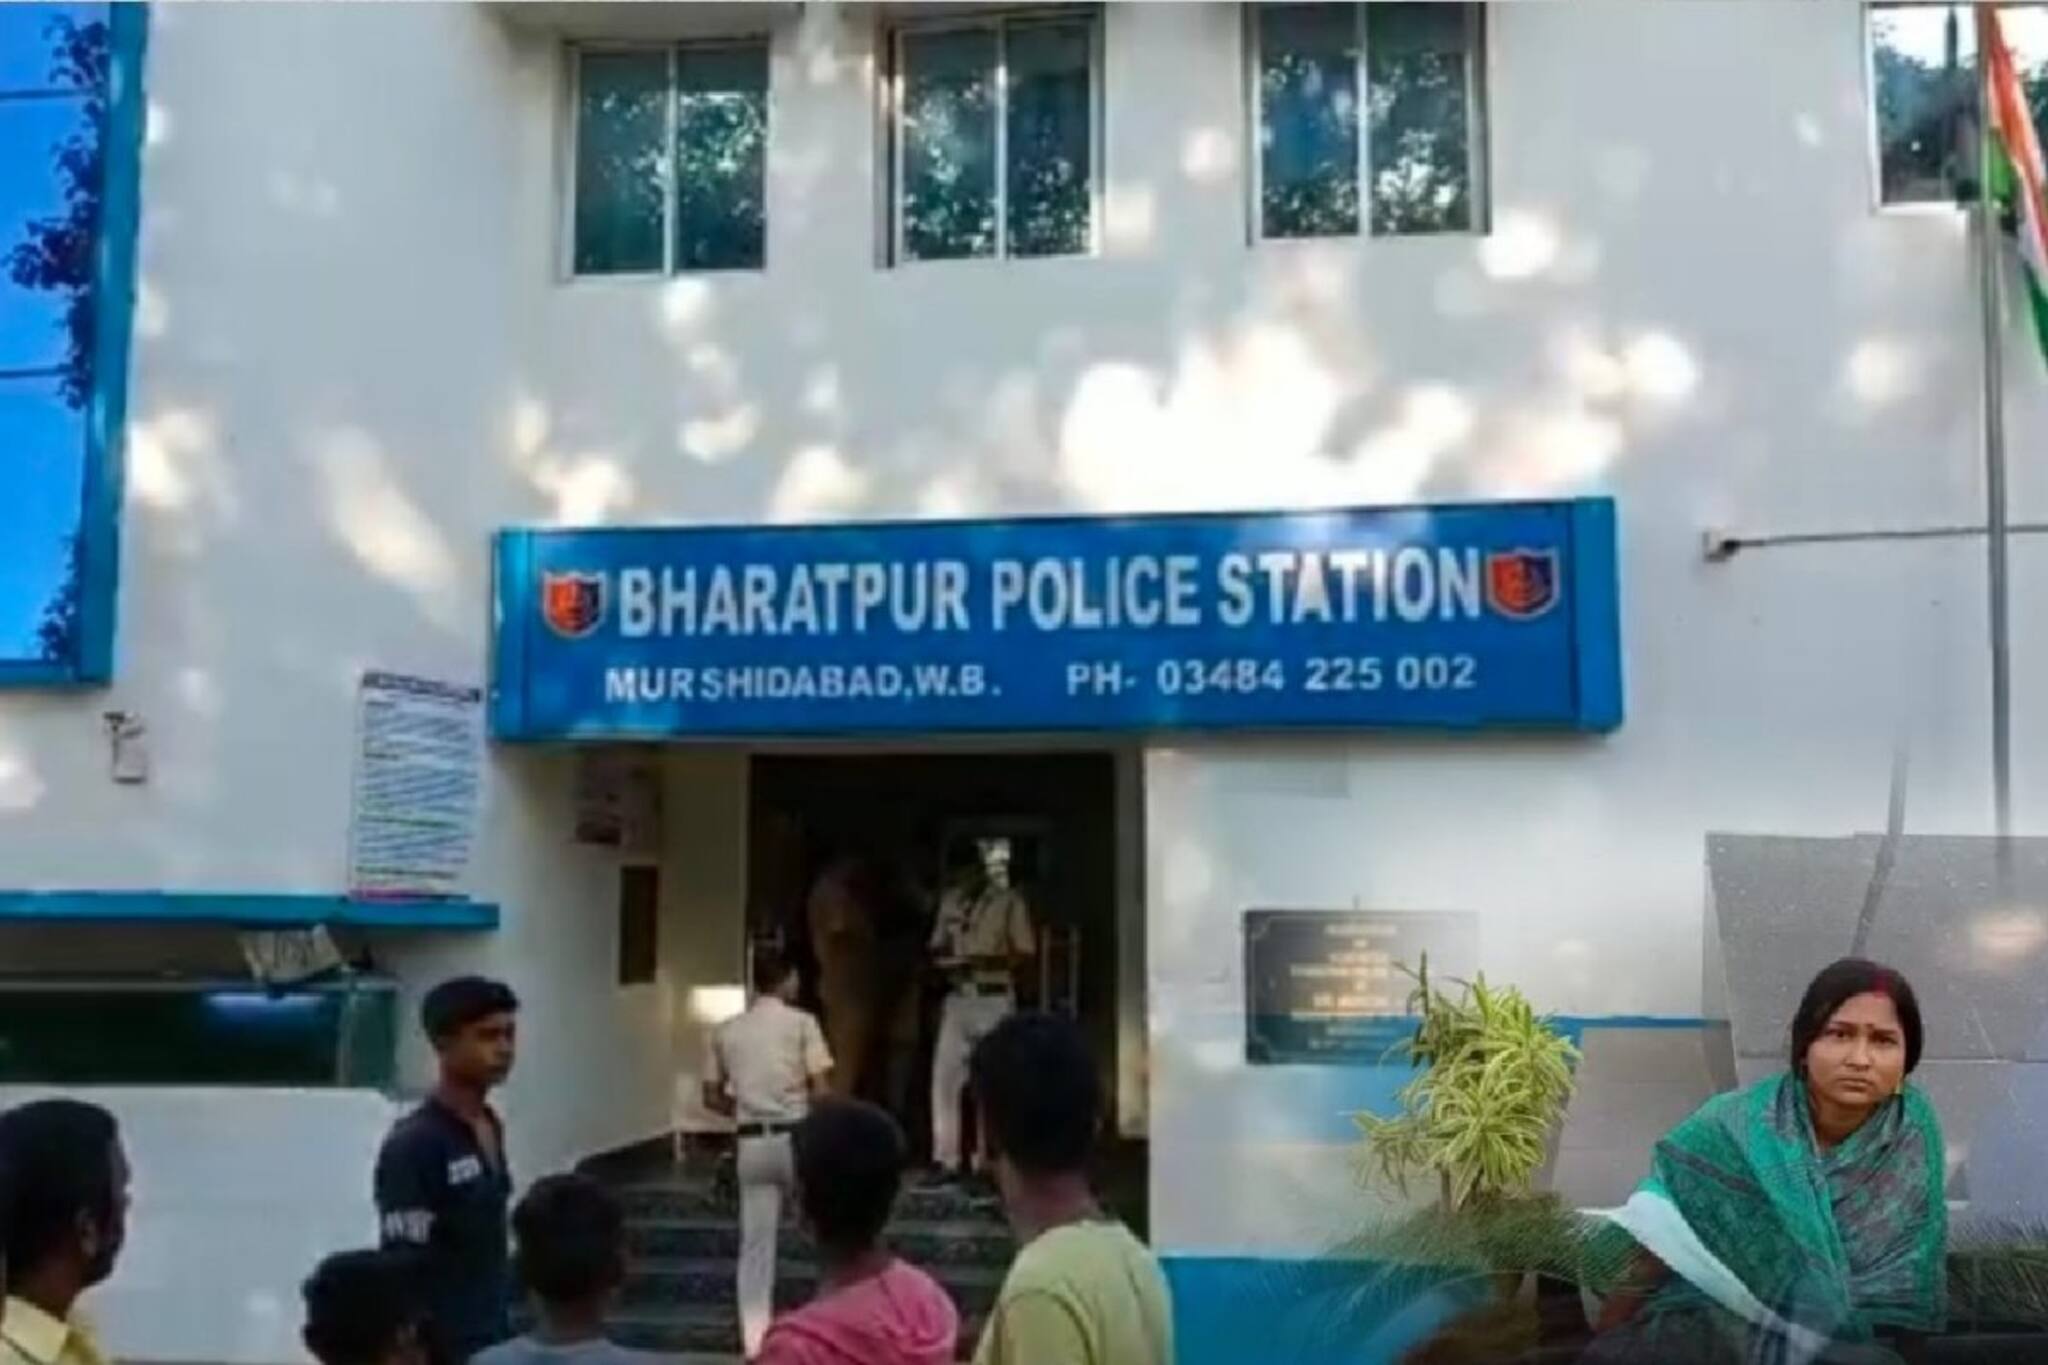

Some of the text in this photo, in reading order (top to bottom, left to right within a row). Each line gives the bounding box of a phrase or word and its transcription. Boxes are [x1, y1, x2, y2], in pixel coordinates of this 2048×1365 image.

[618, 547, 1480, 637] BHARATPUR POLICE STATION
[1066, 655, 1477, 695] PH- 03484 225 002
